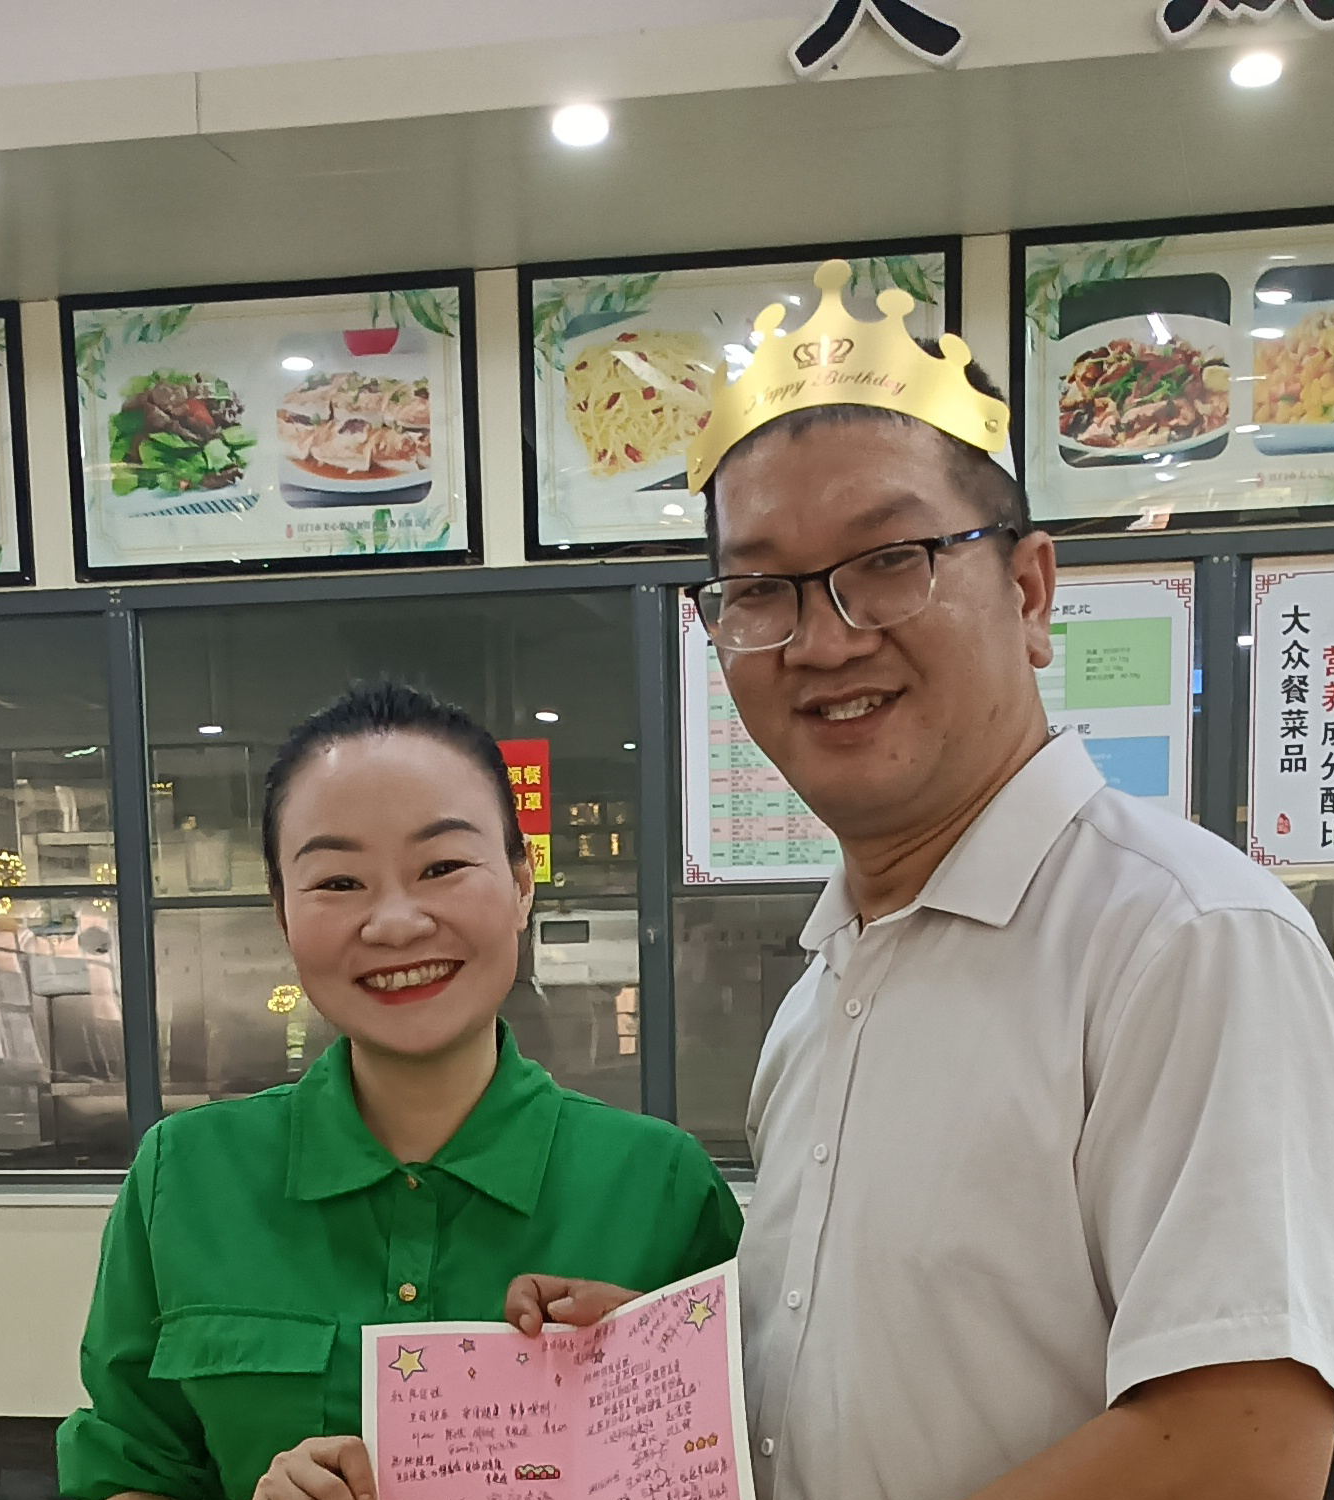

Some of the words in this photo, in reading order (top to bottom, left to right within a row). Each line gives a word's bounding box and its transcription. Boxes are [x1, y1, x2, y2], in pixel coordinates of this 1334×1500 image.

[812, 370, 907, 403] Birthday
[1279, 604, 1312, 773] 大众餐菜品
